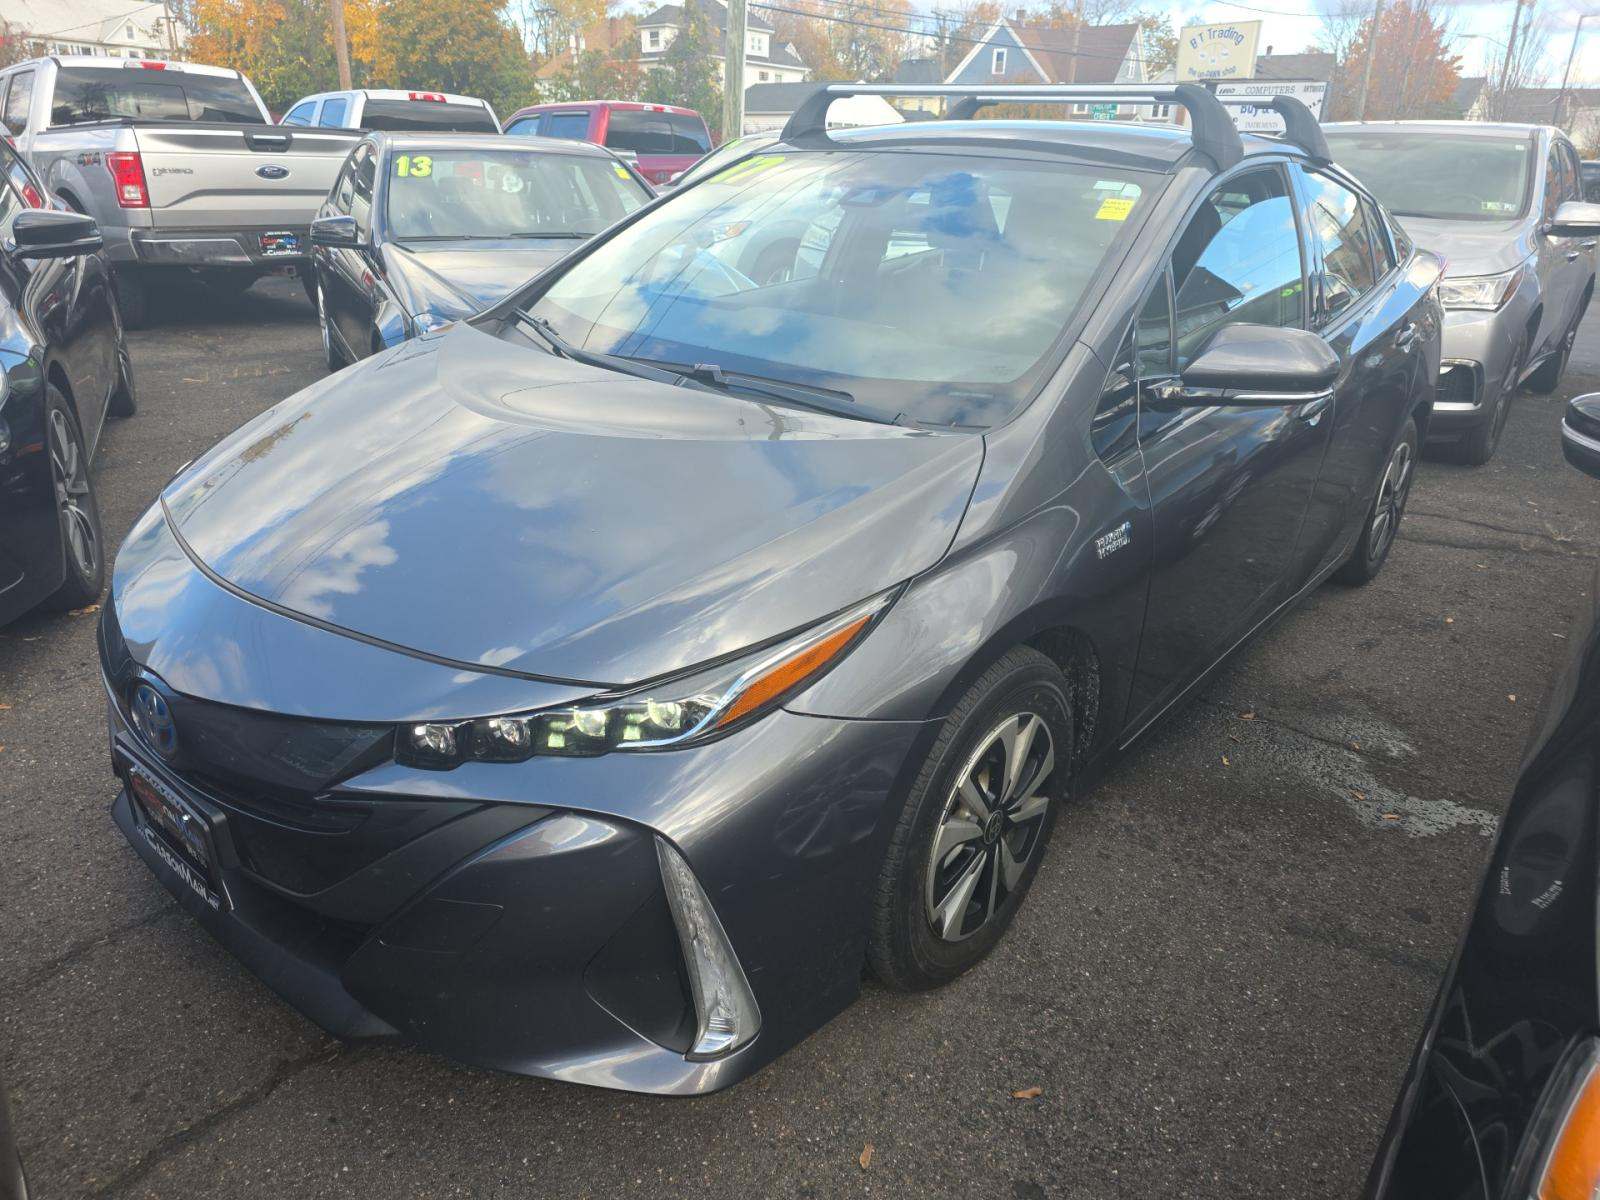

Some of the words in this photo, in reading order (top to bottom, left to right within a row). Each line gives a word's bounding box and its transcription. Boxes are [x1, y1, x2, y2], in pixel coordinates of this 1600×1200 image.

[1190, 37, 1198, 49] B
[1208, 27, 1244, 46] Trading
[1244, 85, 1296, 95] COMPUTERS
[396, 155, 433, 178] 13
